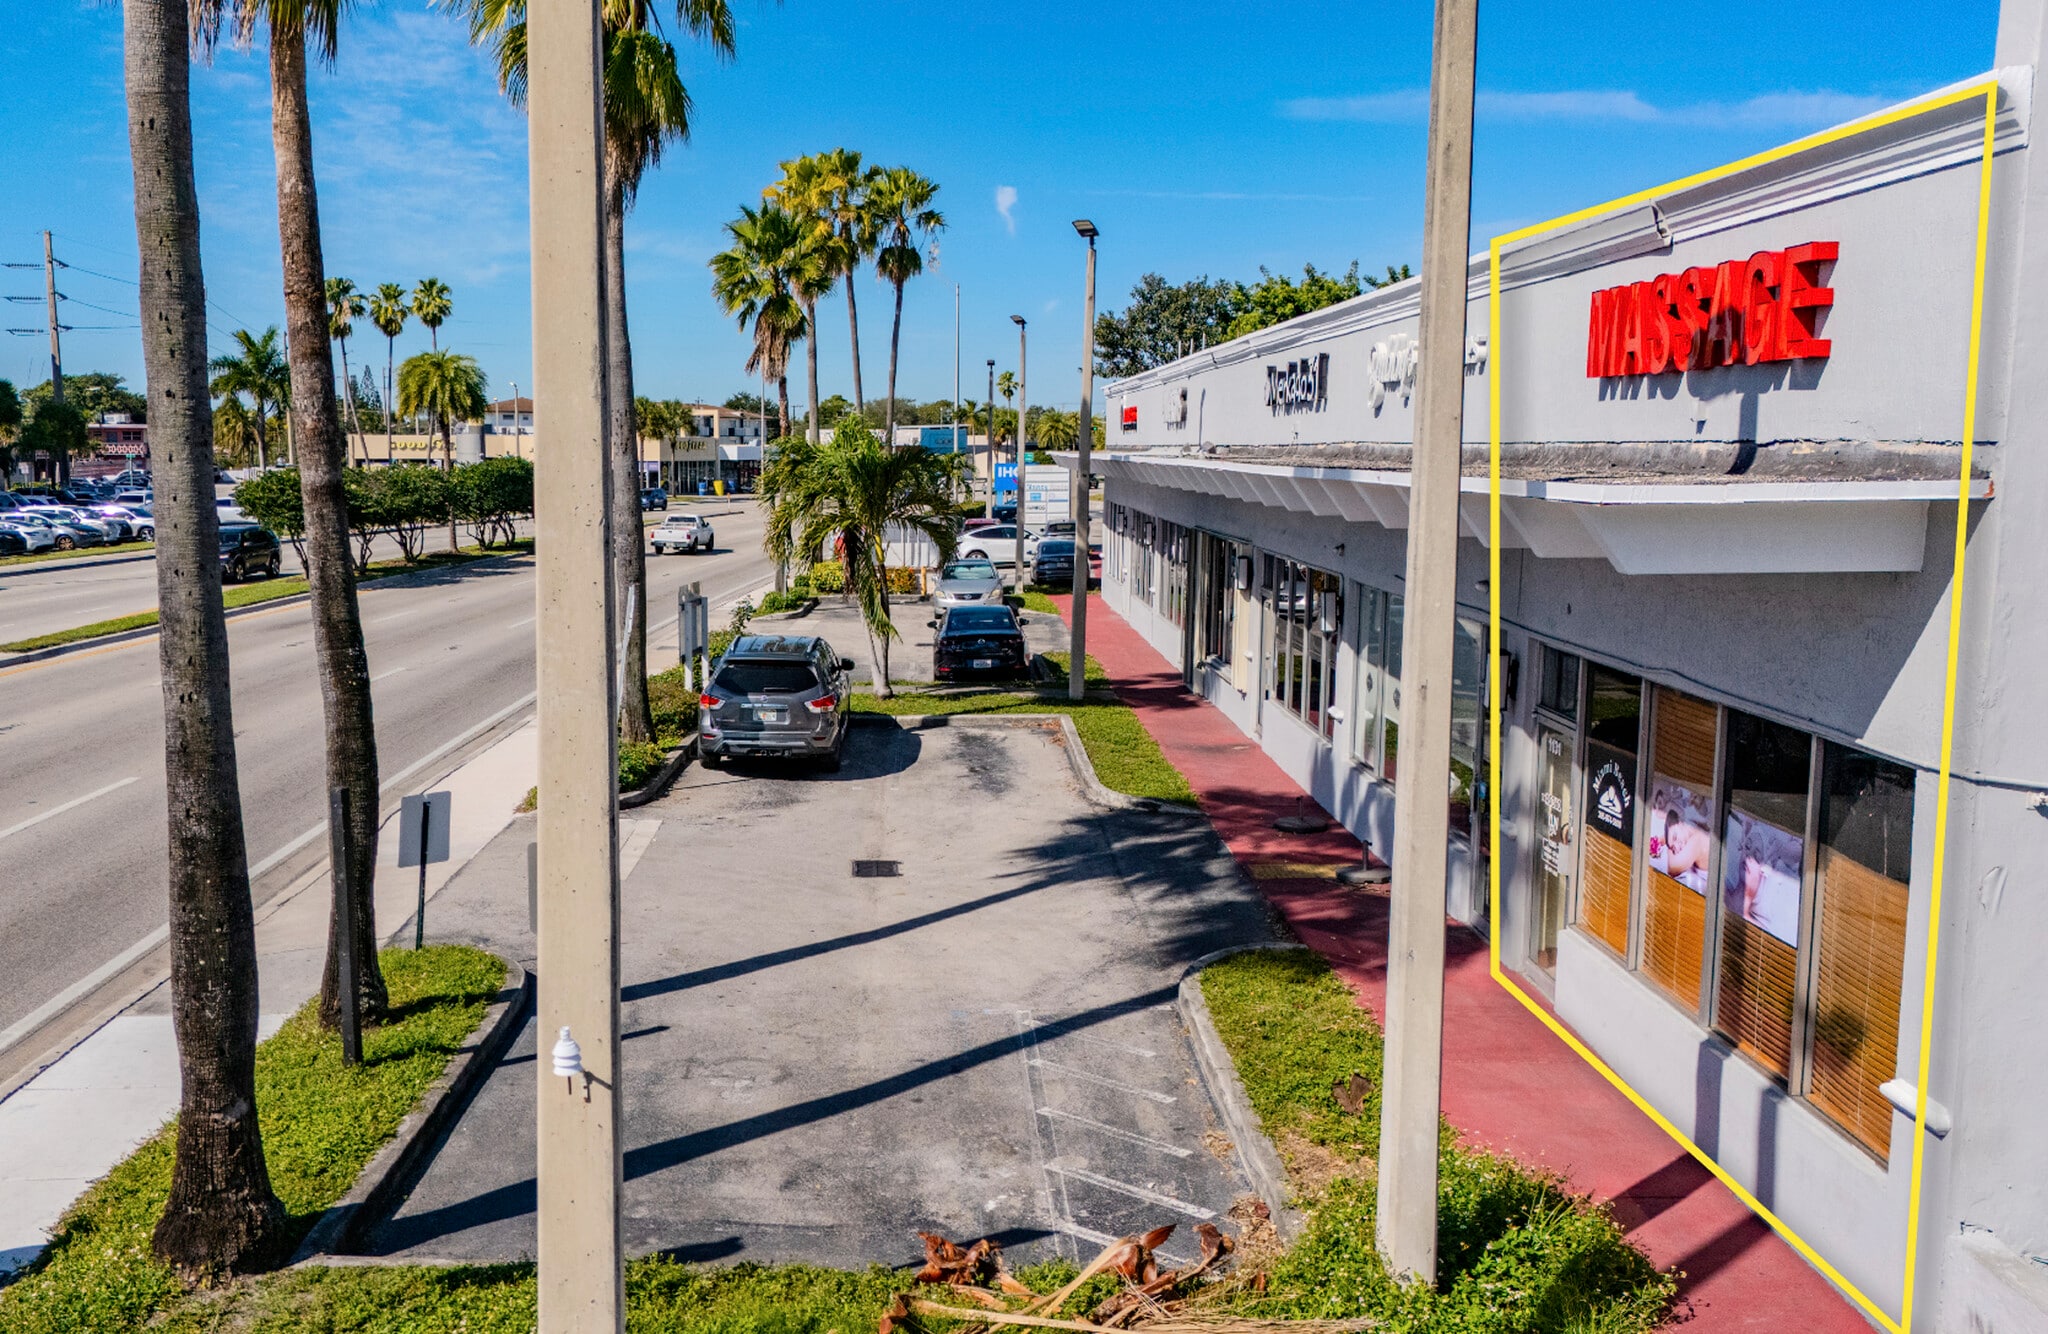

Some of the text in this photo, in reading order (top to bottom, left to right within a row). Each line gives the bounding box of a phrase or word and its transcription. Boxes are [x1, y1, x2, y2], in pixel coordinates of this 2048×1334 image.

[1586, 240, 1840, 378] MASSAGE
[1593, 759, 1631, 808] Miami Beach
